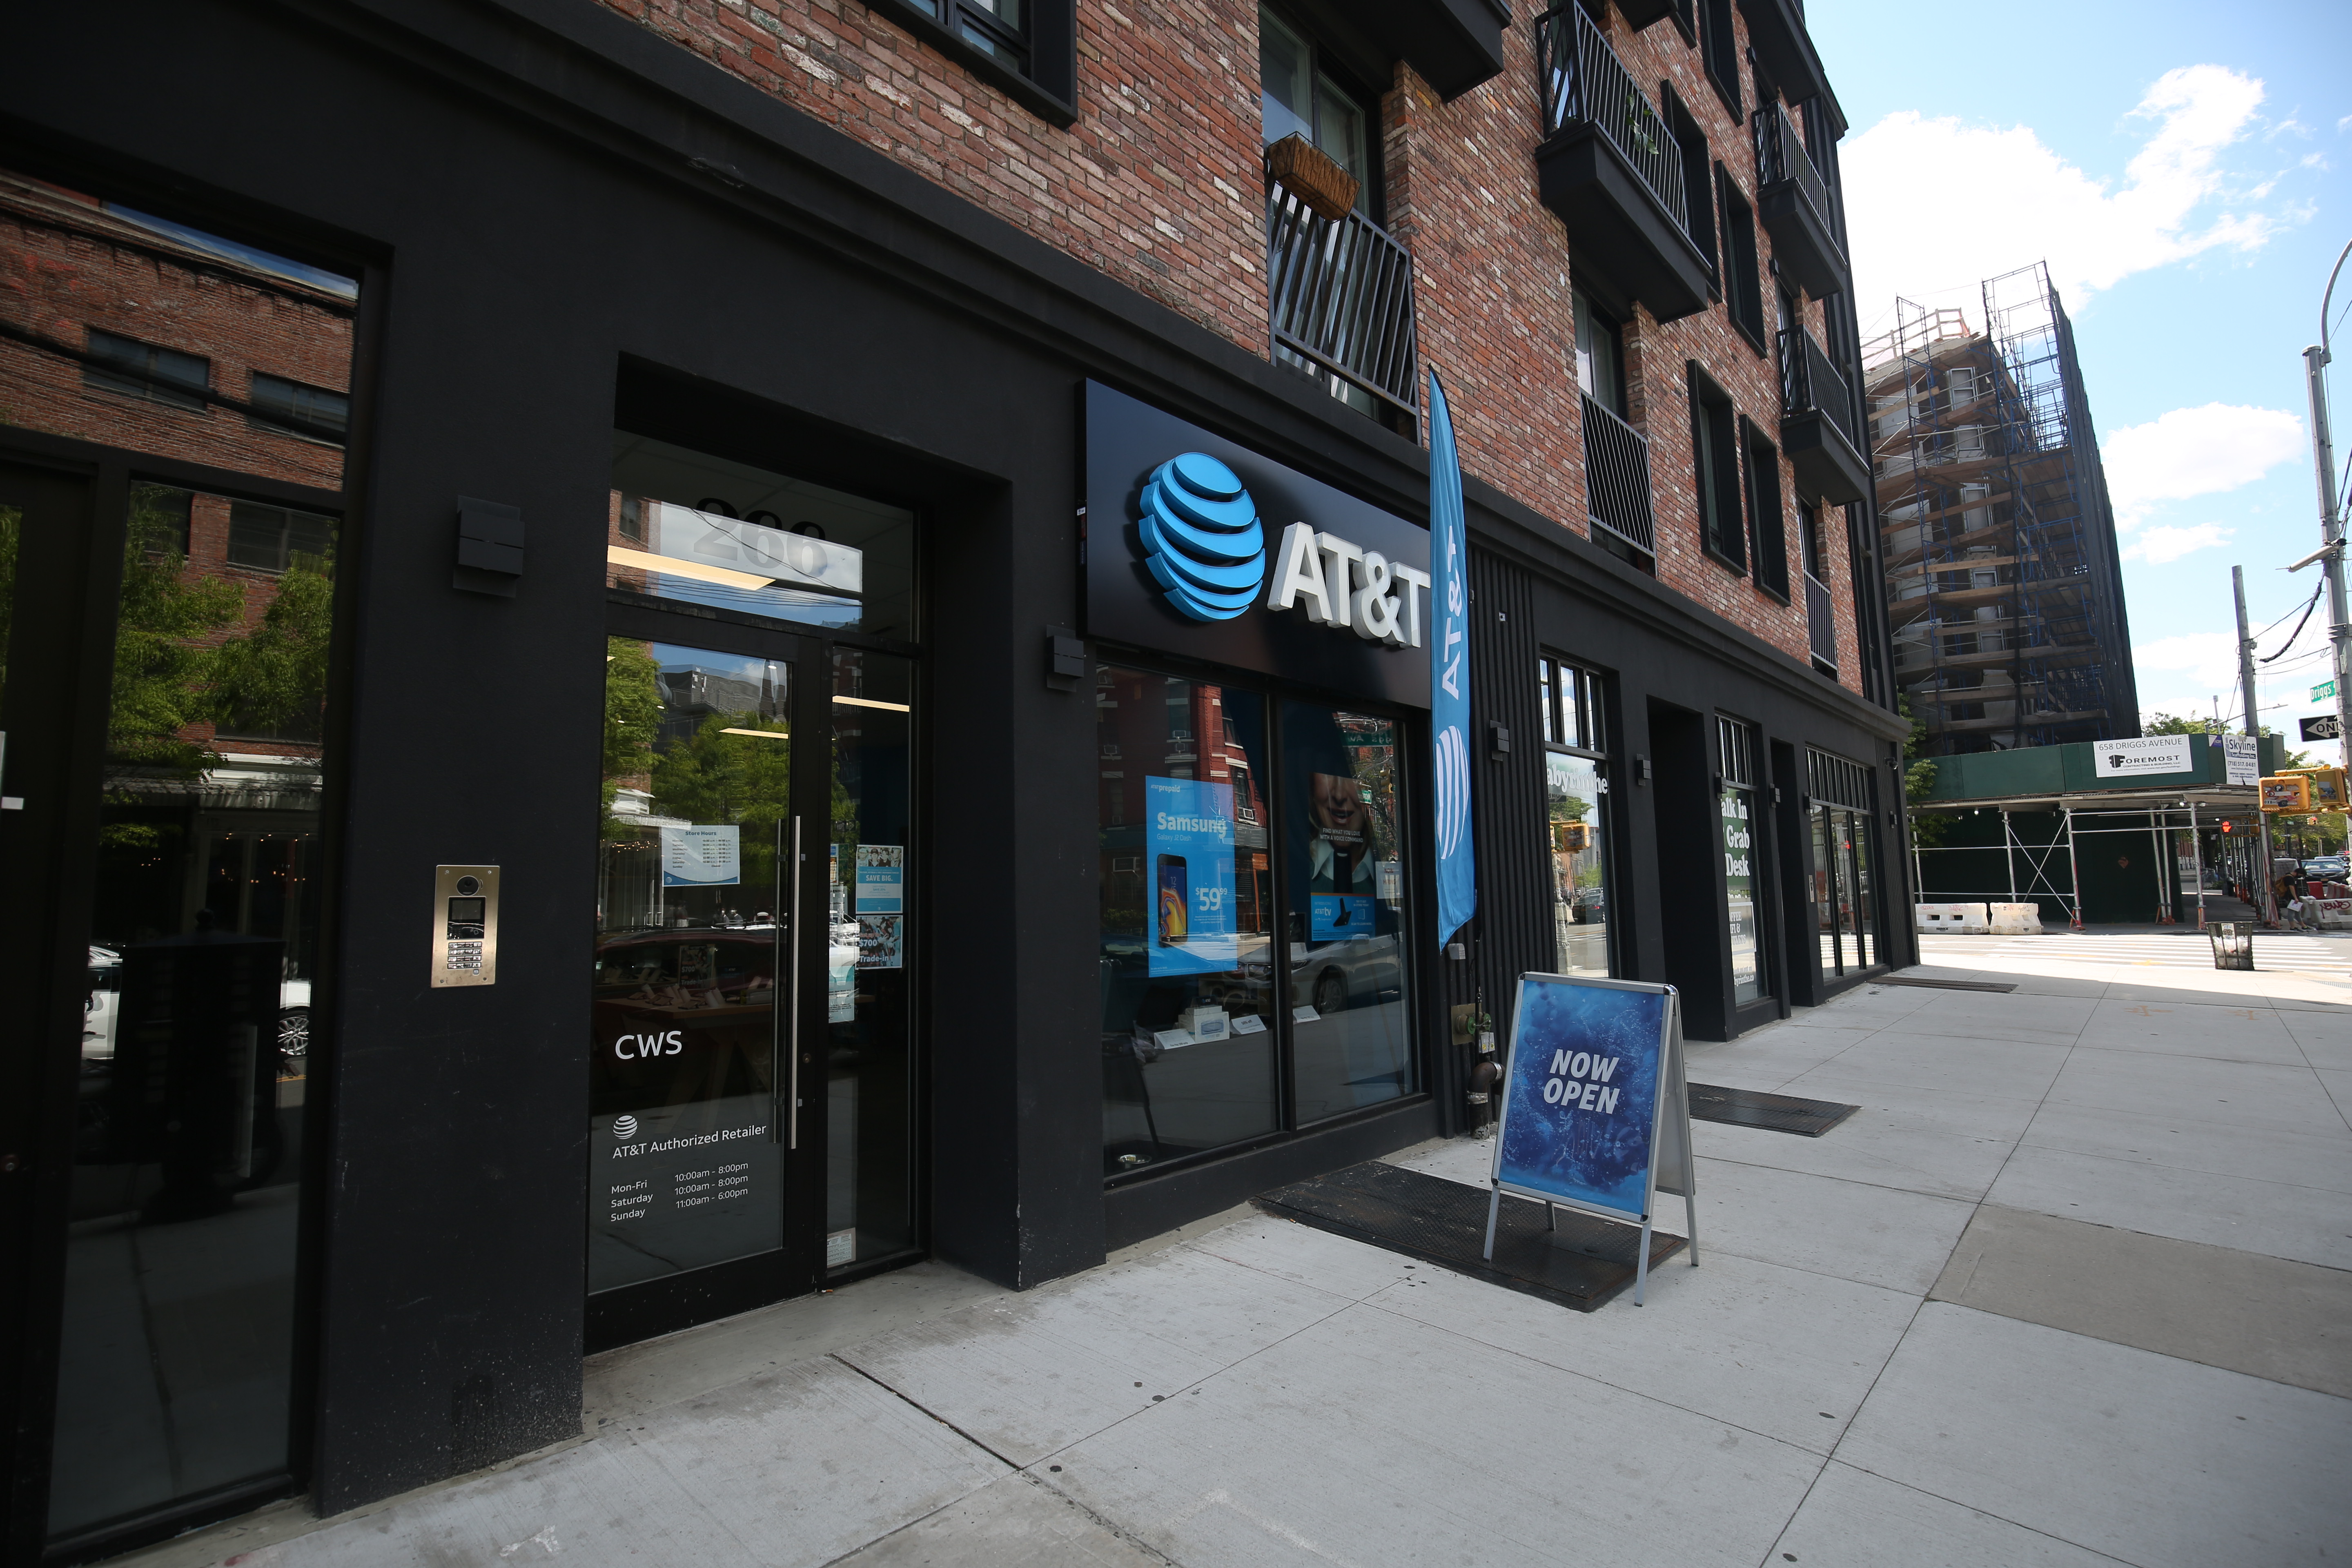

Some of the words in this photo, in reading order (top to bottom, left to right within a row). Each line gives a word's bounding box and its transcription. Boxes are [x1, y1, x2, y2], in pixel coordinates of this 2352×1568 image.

[694, 497, 827, 577] 266
[1267, 521, 1431, 648] AT&T
[1442, 526, 1463, 701] AT&T
[2311, 684, 2331, 700] Driggs
[2116, 741, 2146, 750] DRIGGS
[2148, 738, 2183, 747] AVENUE
[2229, 738, 2255, 753] Skyline
[2114, 755, 2180, 768] FOREMOST
[1159, 785, 1180, 793] prepaid
[1547, 764, 1608, 794] abyrinthe
[1721, 797, 1737, 818] alk
[1737, 798, 1748, 820] In
[1157, 812, 1226, 838] Samsung
[1726, 824, 1750, 849] Grab
[1725, 853, 1750, 876] Desk
[1170, 877, 1176, 885] 12
[1324, 907, 1332, 916] tv
[1729, 911, 1742, 922] FFEE
[1737, 923, 1741, 933] &
[859, 939, 877, 947] $700
[1734, 974, 1754, 987] byrinthe.co
[615, 1031, 682, 1059] CWS
[1550, 1049, 1619, 1082] NOW
[1544, 1078, 1620, 1114] OPEN
[612, 1143, 647, 1159] AT&T
[650, 1131, 719, 1153] Authorized
[722, 1125, 766, 1141] Retailer
[611, 1180, 648, 1194] Mon-Fri
[675, 1169, 710, 1183] 10:00am
[718, 1162, 748, 1175] 8:00pm
[611, 1193, 653, 1208] Saturday
[675, 1182, 709, 1196] 10:00am
[718, 1175, 748, 1187] 8:00pm
[610, 1207, 646, 1222] Sunday
[676, 1195, 709, 1209] 11:00am
[718, 1187, 748, 1200] 6:00pm
